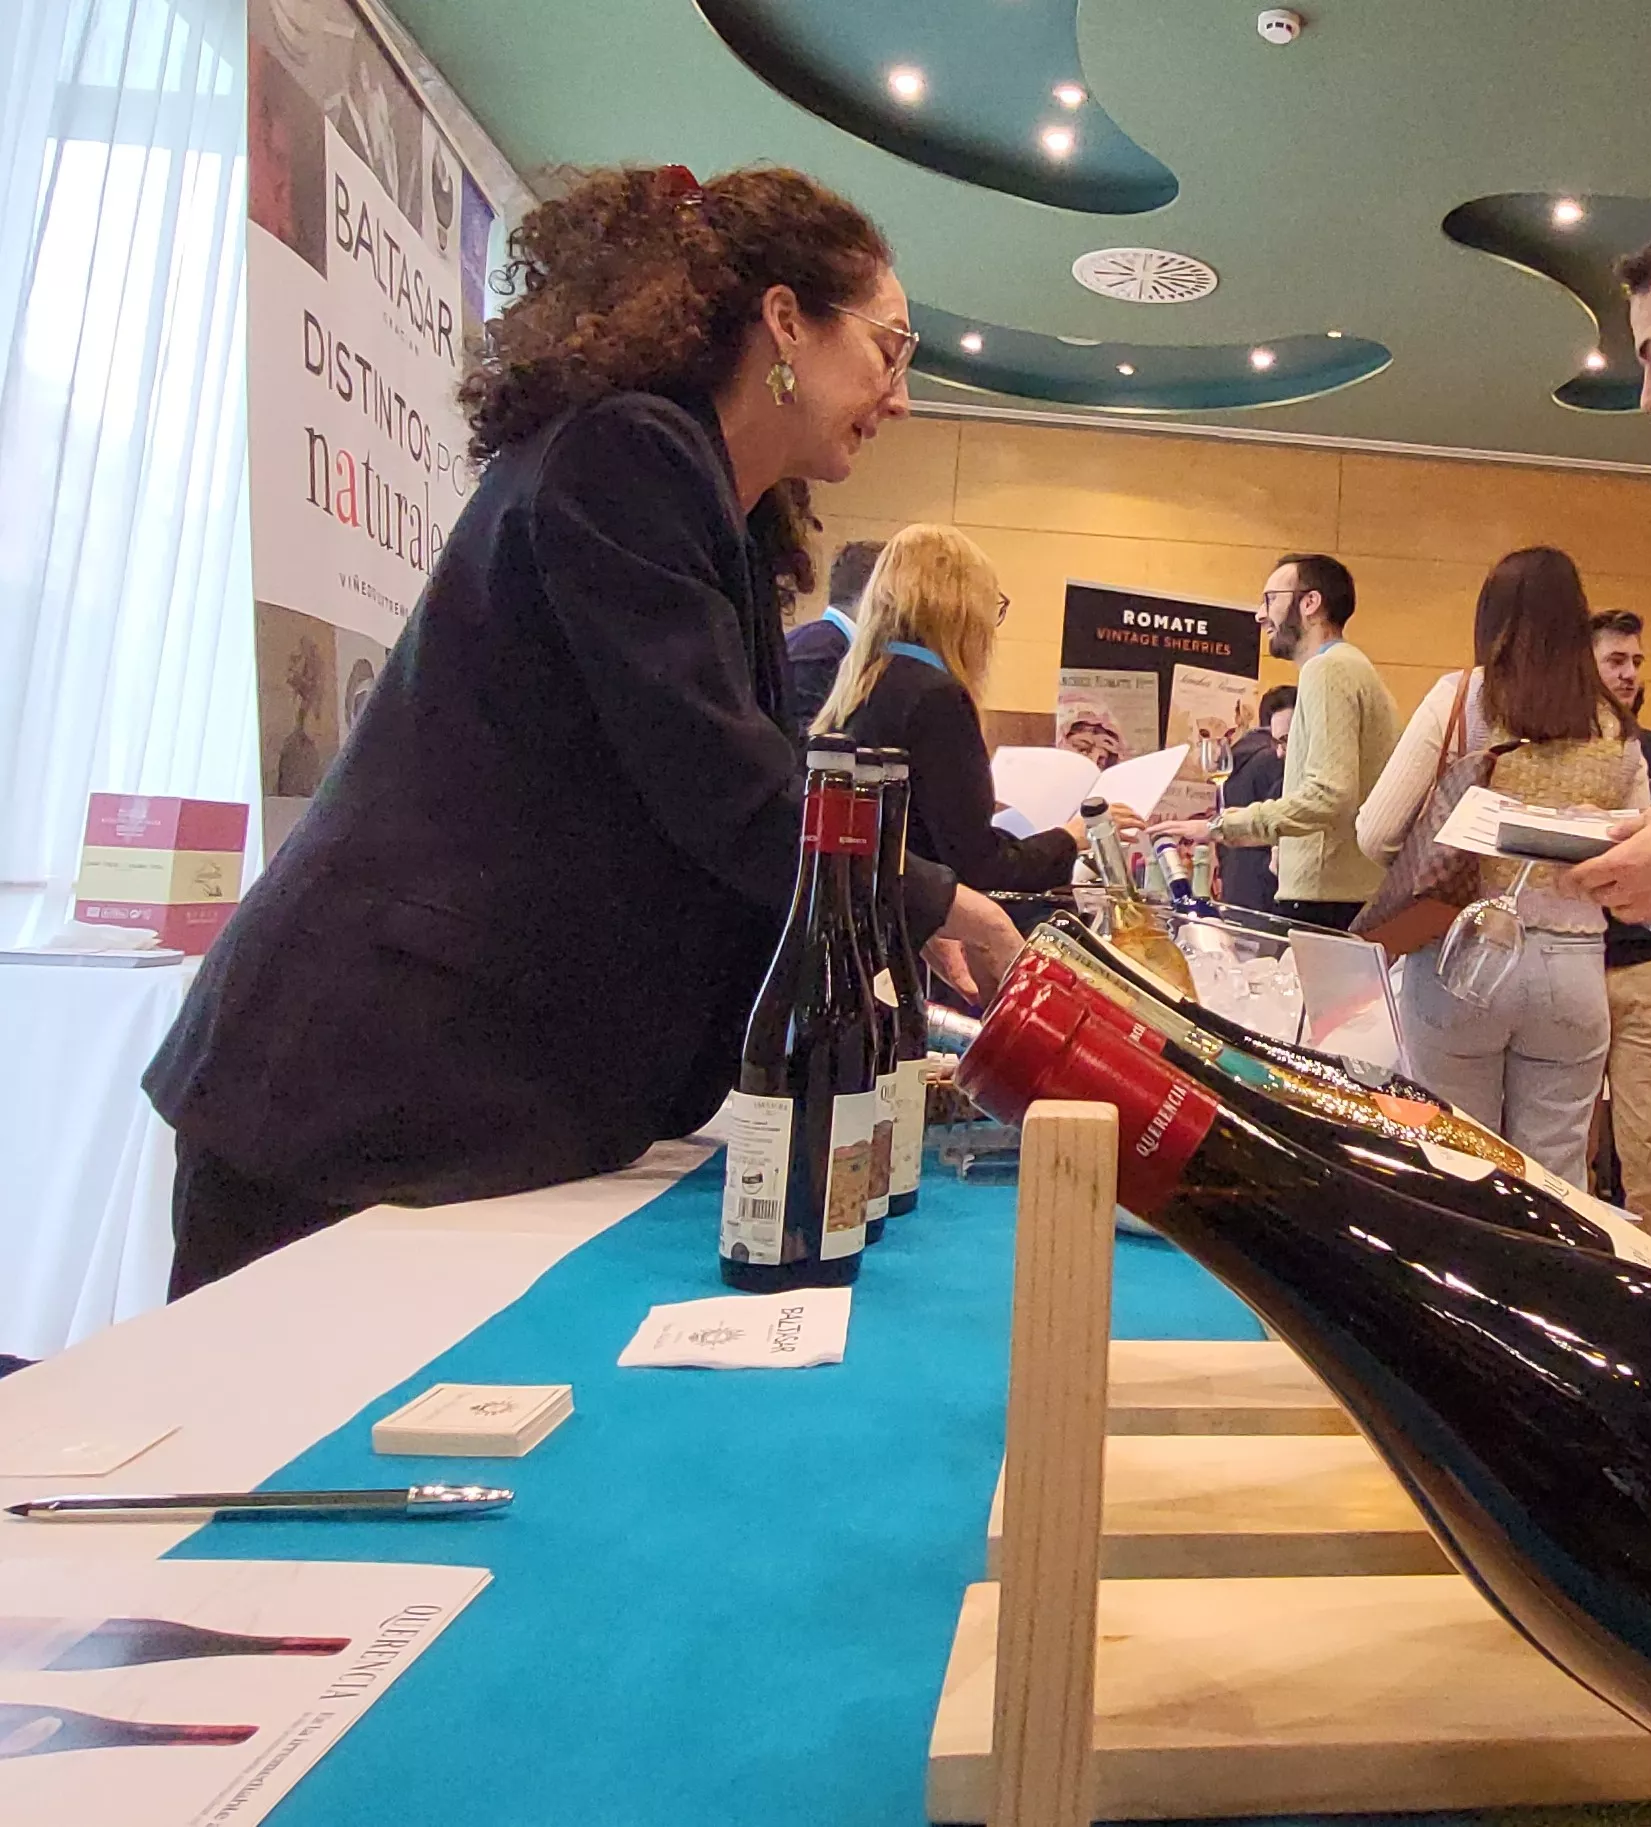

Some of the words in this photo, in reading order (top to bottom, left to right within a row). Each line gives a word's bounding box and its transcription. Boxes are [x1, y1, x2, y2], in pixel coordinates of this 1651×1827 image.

[335, 172, 455, 367] BALTASAR
[303, 308, 431, 474] DISTINTOS
[437, 442, 467, 498] PO
[304, 426, 444, 576] naturale
[1095, 627, 1159, 647] VINTAGE
[1163, 635, 1232, 657] SHERRIES
[1122, 609, 1209, 636] ROMATE
[1136, 1081, 1188, 1157] QUERENCIA
[318, 1604, 443, 1700] QUERENCIA
